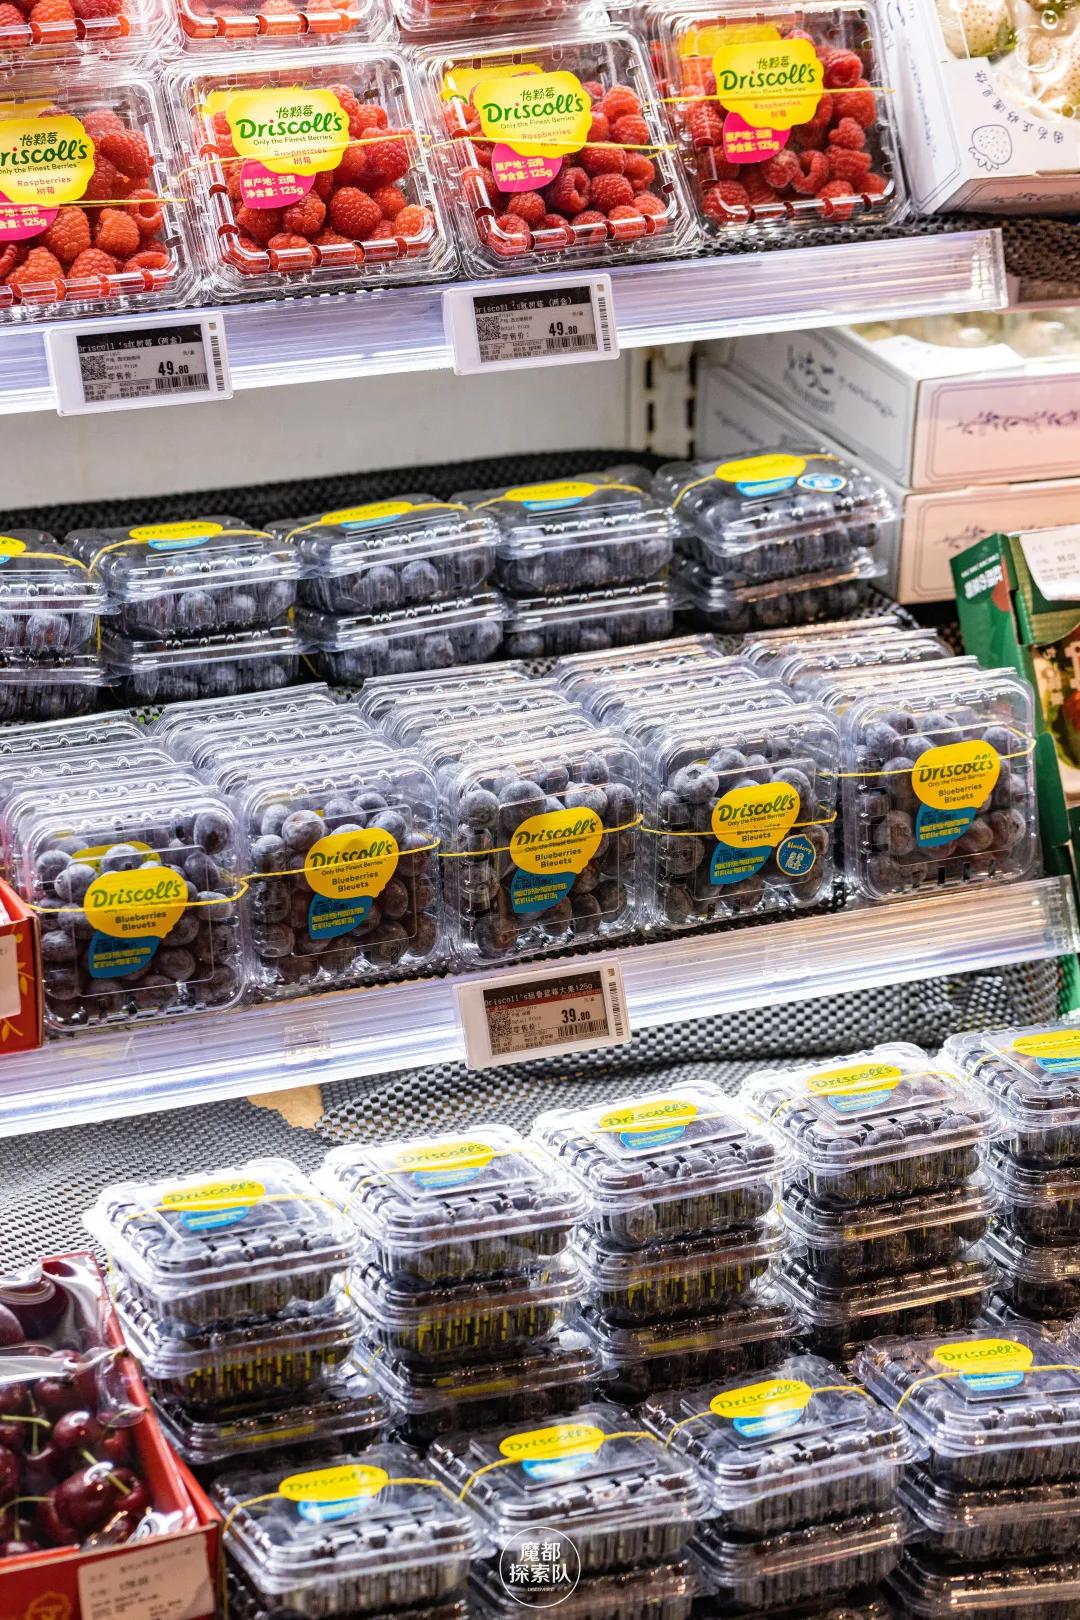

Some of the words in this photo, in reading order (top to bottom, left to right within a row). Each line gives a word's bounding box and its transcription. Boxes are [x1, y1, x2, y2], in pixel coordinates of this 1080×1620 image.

[720, 63, 815, 91] Driscoll's
[276, 105, 314, 119] 怡颗莓
[482, 93, 584, 122] Driscoll's
[235, 111, 343, 139] Driscoll's
[20, 132, 58, 147] 怡颗莓
[253, 139, 270, 147] Only
[521, 130, 572, 140] Raspberries
[0, 139, 88, 167] riscoll's
[14, 165, 26, 174] the
[28, 164, 50, 172] Finest
[17, 177, 72, 187] Raspberries
[549, 321, 578, 337] 49.80
[158, 360, 189, 376] 49.80
[938, 783, 983, 797] Blueberries
[944, 794, 974, 804] Bleuets
[718, 794, 796, 822] Driscoll's
[515, 819, 597, 847] Driscoll's
[741, 832, 771, 842] Bleuets
[310, 840, 393, 871] Driscoll's
[535, 848, 582, 862] Blueberries
[540, 858, 572, 868] Bleuets
[332, 872, 379, 886] Blueberries
[338, 881, 369, 892] Bleuets
[91, 880, 181, 908] Driscoll's
[115, 911, 167, 924] Blueberries
[121, 920, 157, 931] Bleuets
[561, 1008, 591, 1024] 39.80
[812, 1065, 893, 1088] Driscoll's
[604, 1103, 689, 1126] Driscoll's
[167, 1181, 255, 1203] Driscoll's
[937, 1343, 1022, 1361] Driscoll's
[714, 1382, 801, 1409] Driscoll's
